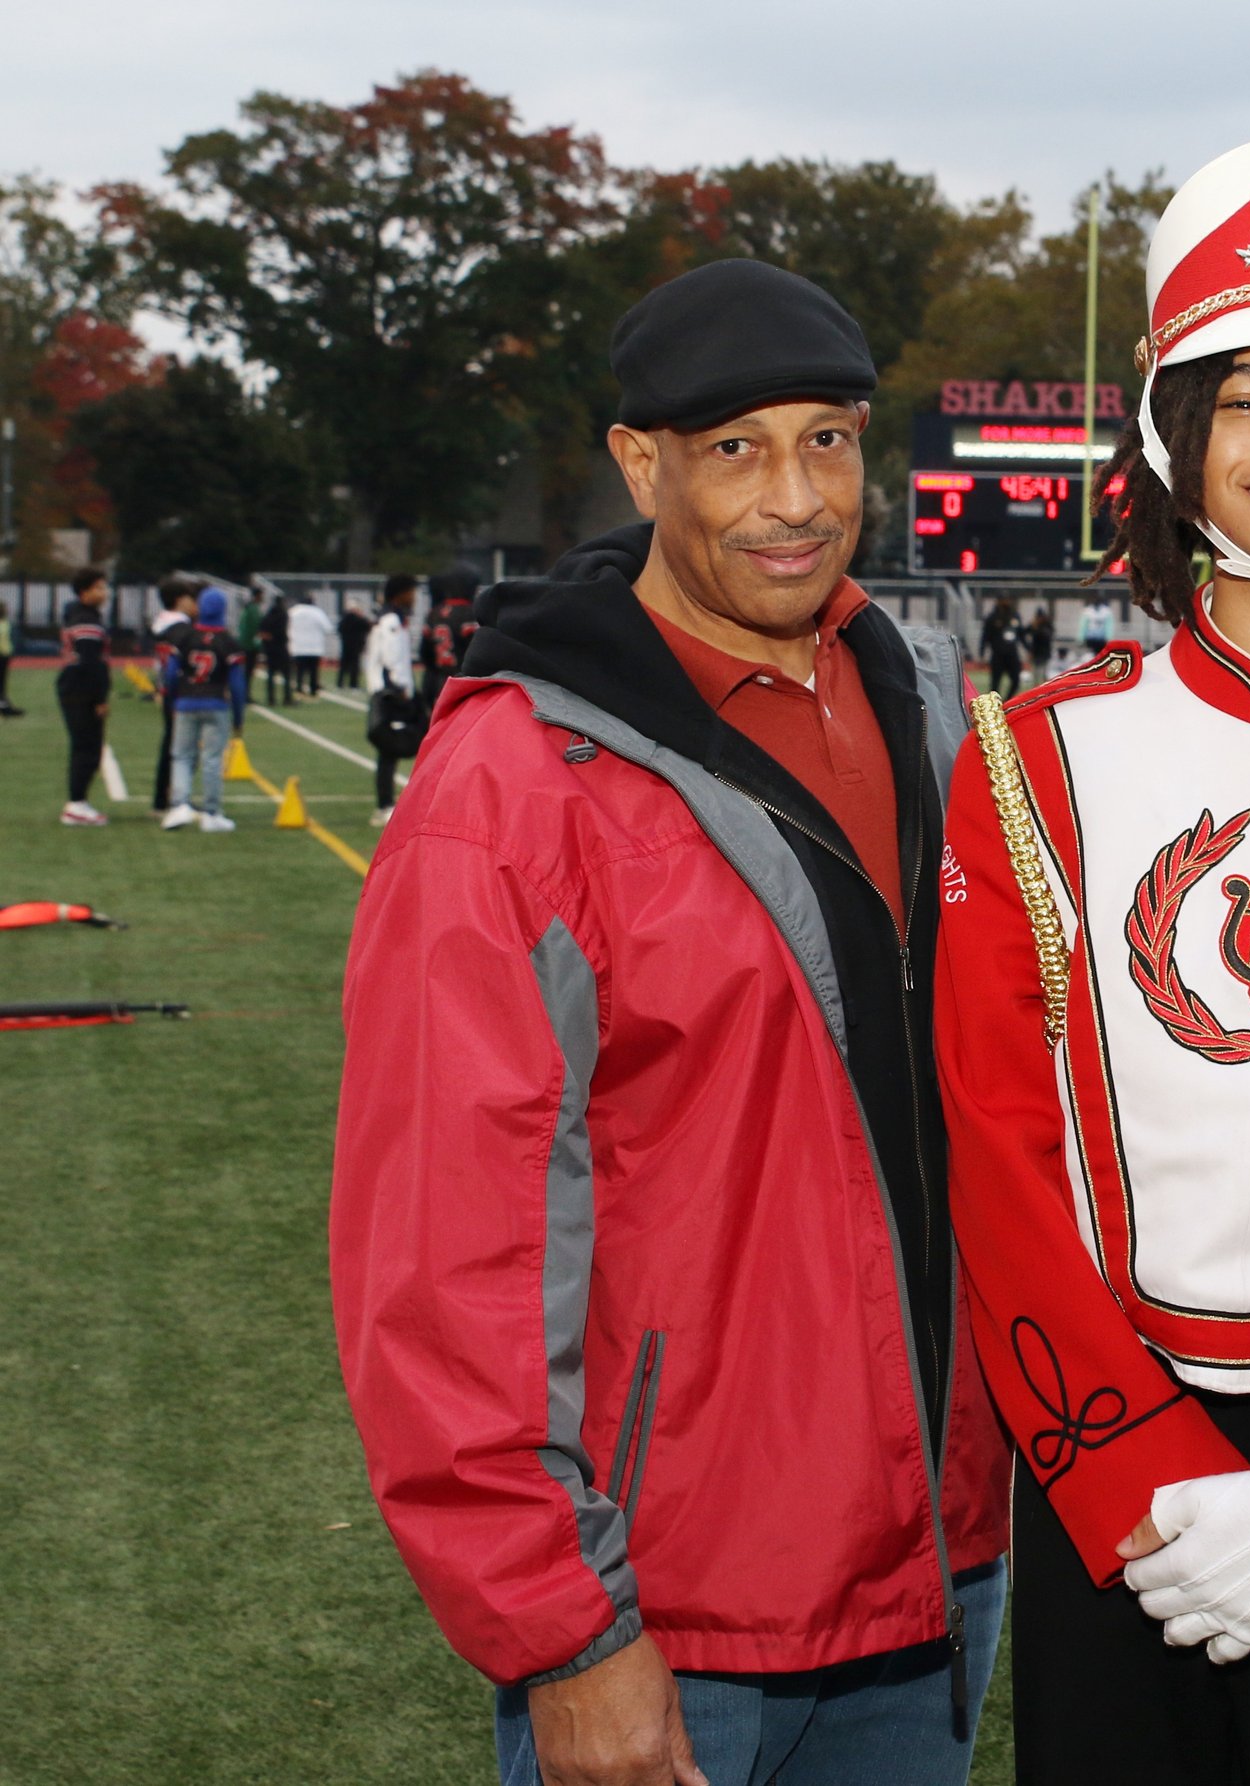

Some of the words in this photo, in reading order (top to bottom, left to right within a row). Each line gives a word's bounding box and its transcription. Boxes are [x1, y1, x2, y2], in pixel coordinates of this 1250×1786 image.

[941, 380, 1126, 417] SHAKER
[943, 491, 962, 518] 0
[188, 651, 217, 684] 7
